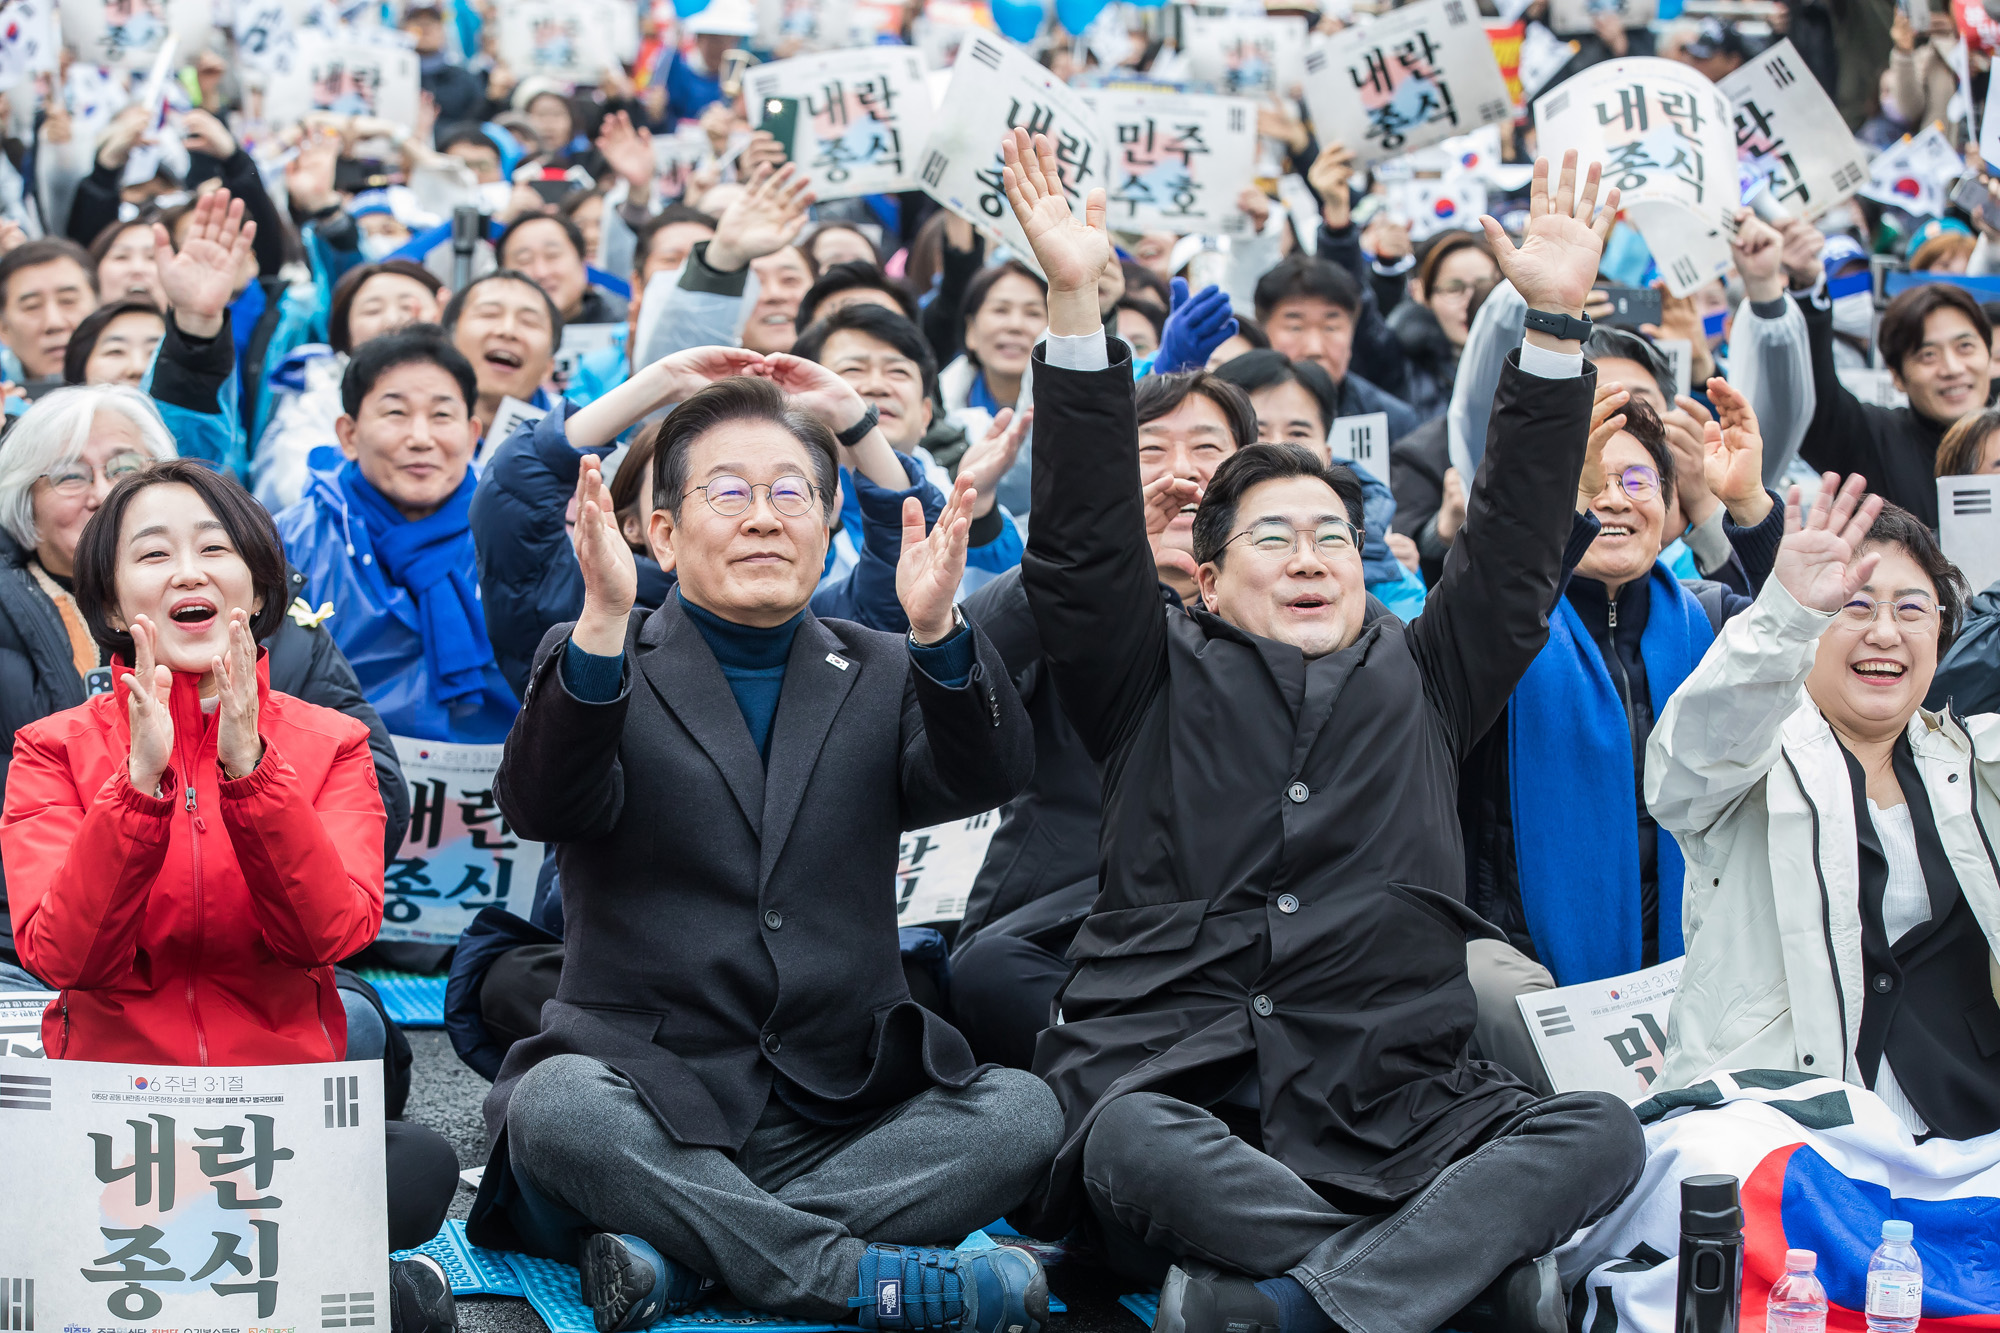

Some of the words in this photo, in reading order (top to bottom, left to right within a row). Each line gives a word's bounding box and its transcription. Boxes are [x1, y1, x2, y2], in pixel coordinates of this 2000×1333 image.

[1349, 31, 1440, 93] 내란
[805, 74, 898, 127] 내란
[1365, 82, 1458, 149] 종식
[1596, 83, 1705, 147] 내란
[1734, 101, 1783, 158] 란
[813, 129, 903, 183] 종식
[1117, 118, 1211, 166] 민주
[1602, 141, 1705, 203] 종식
[1110, 174, 1207, 217] 수호
[1768, 153, 1810, 203] 식
[1603, 1013, 1668, 1087] 민
[87, 1112, 295, 1212] 내란
[80, 1219, 280, 1320] 종식
